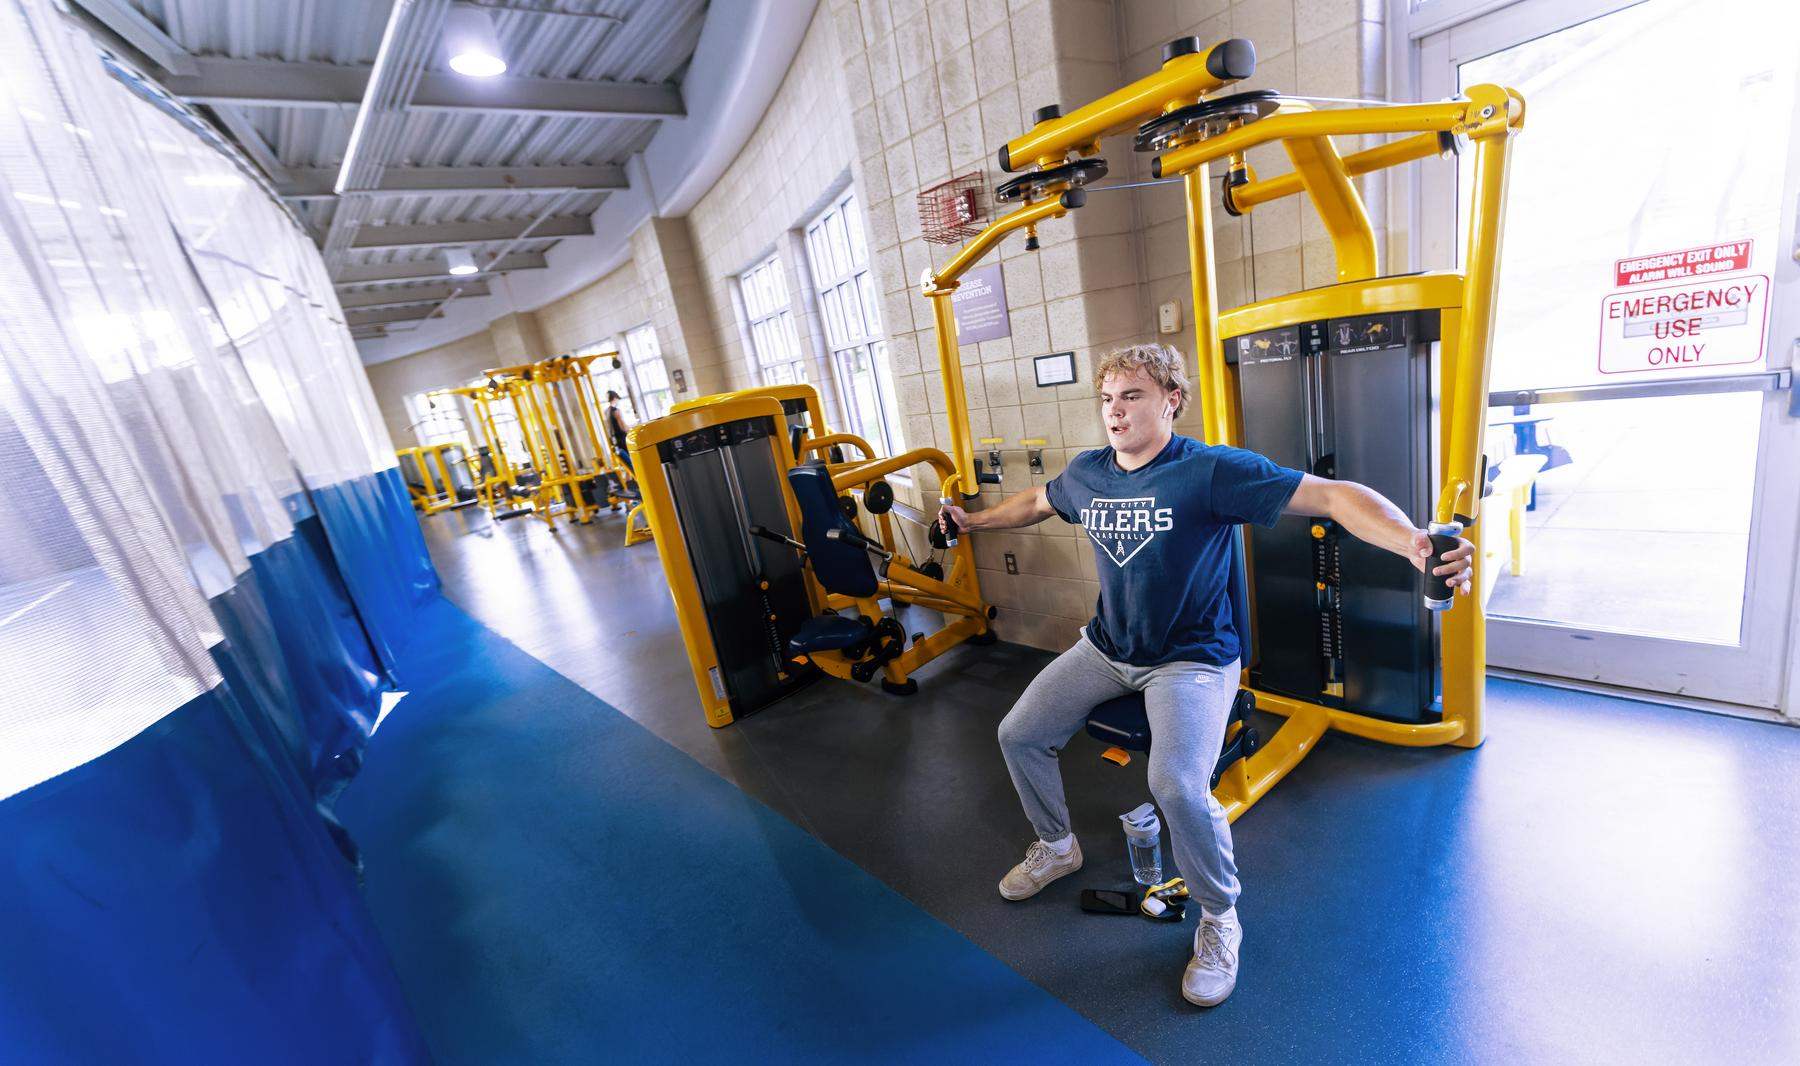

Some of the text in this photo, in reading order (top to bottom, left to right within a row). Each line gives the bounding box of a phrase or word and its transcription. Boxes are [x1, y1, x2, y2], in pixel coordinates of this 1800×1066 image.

[1620, 244, 1746, 273] EMERGENCY EXIT ONLY
[1628, 260, 1735, 284] ALARM WILL SOUND
[1609, 284, 1758, 320] EMERGENCY
[1655, 317, 1703, 340] USE
[1648, 343, 1706, 365] ONLY
[1081, 508, 1173, 532] OILERS
[1096, 532, 1145, 540] BASEBALL
